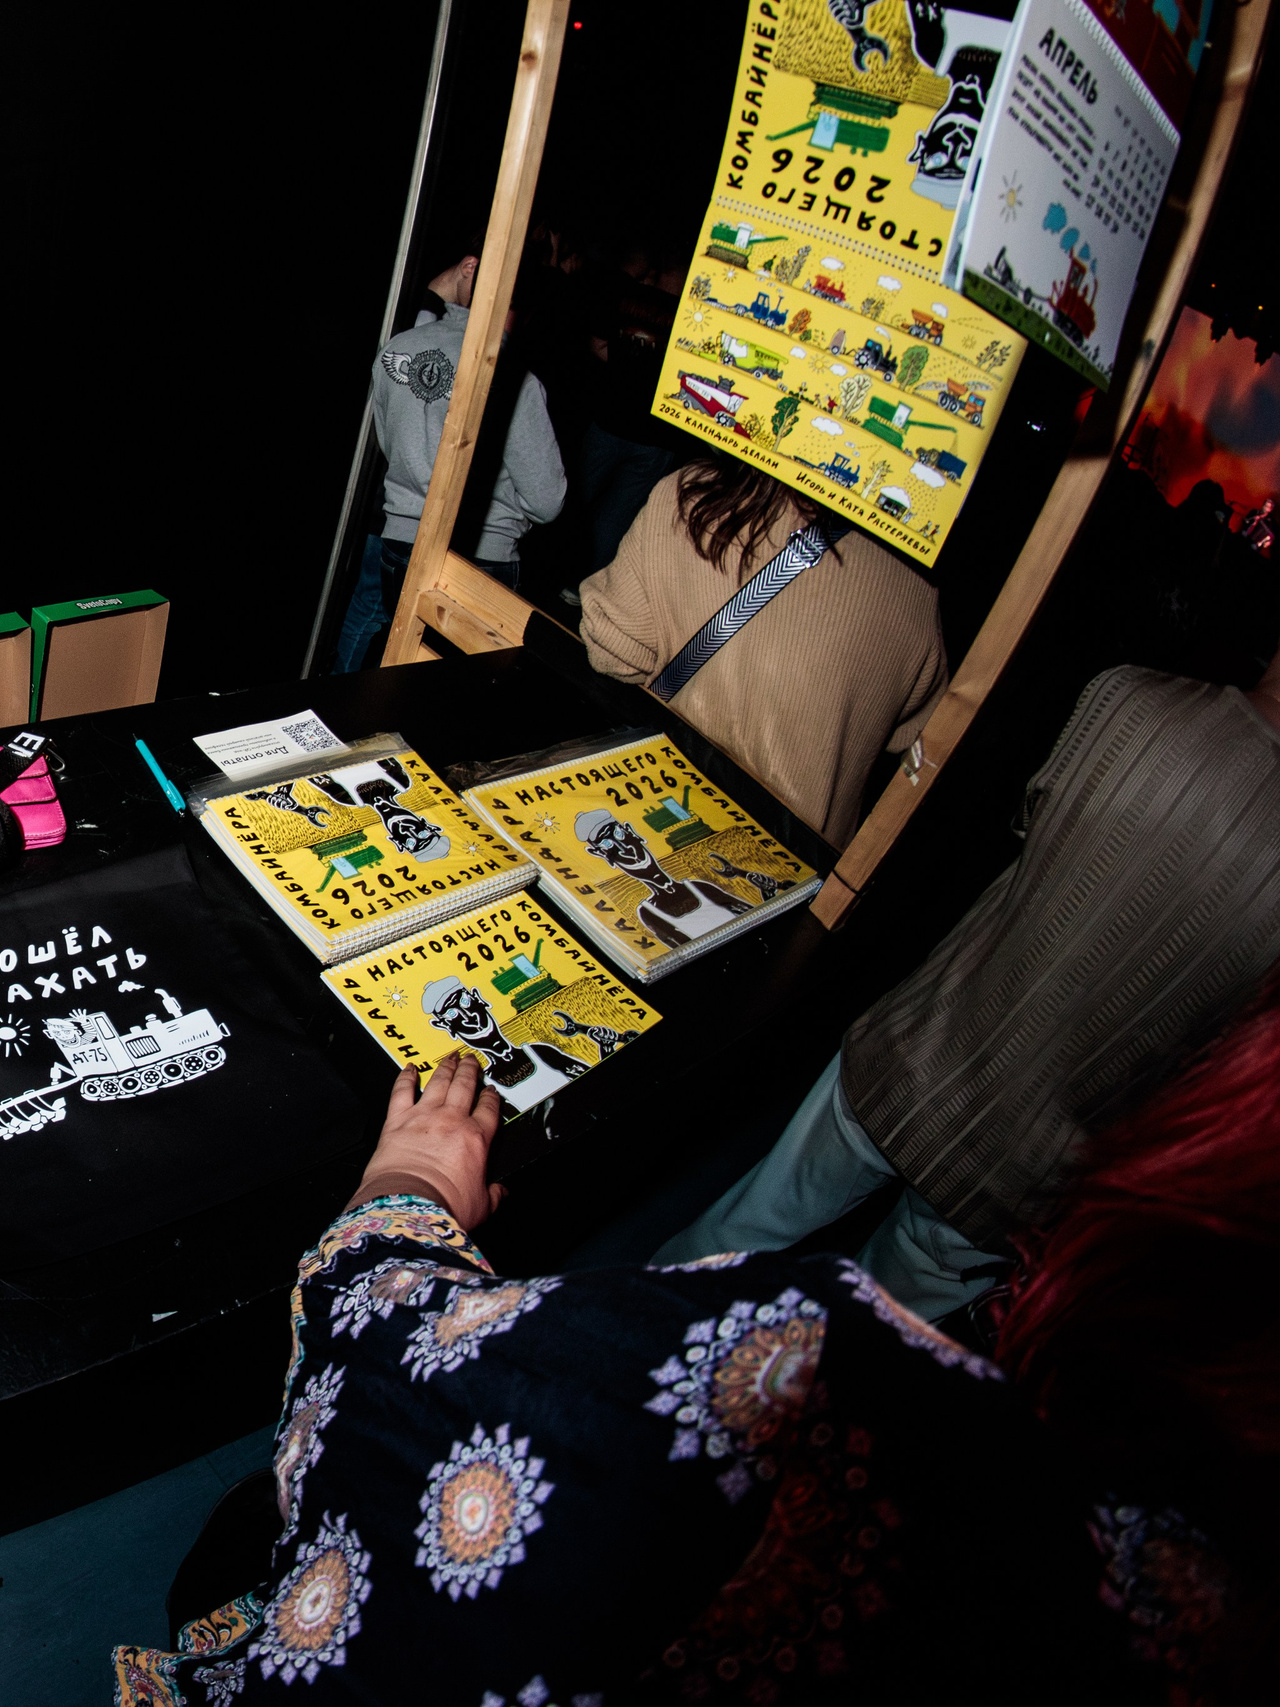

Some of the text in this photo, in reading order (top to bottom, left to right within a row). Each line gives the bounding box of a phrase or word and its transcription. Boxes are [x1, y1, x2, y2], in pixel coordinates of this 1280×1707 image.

[726, 0, 782, 190] КОМБАЙНЁР
[1039, 27, 1099, 105] АПРЕЛЬ
[771, 148, 891, 203] 2026
[761, 181, 943, 257] СТОЯЩЕГО
[658, 403, 682, 419] 2026
[684, 416, 739, 449] КАЛЕНДАРЬ
[740, 445, 780, 469] ДЕЛАЛИ
[76, 597, 123, 610] SvetoCopy
[220, 752, 264, 767] оплаты
[266, 746, 289, 756] Для
[515, 752, 657, 806] НАСТОЯЩЕГО
[405, 759, 518, 863] КАЛЕНДАРЬ
[606, 770, 678, 807] 2026
[660, 746, 803, 873] КОМБАЙНЁРА
[224, 807, 340, 930] КОМБАЙНЁРА
[331, 865, 418, 905] 2026
[350, 860, 501, 920] НАСТОЯЩЕГО
[491, 798, 656, 949] КАЛЕНДАРЬ
[366, 909, 512, 982] НАСТОЯЩЕГО
[457, 925, 531, 971] 2026
[516, 900, 647, 1020] КОМБАЙНЁРА
[72, 1048, 108, 1065] ДТ-75
[344, 977, 433, 1073] ЕНДАРЬ
